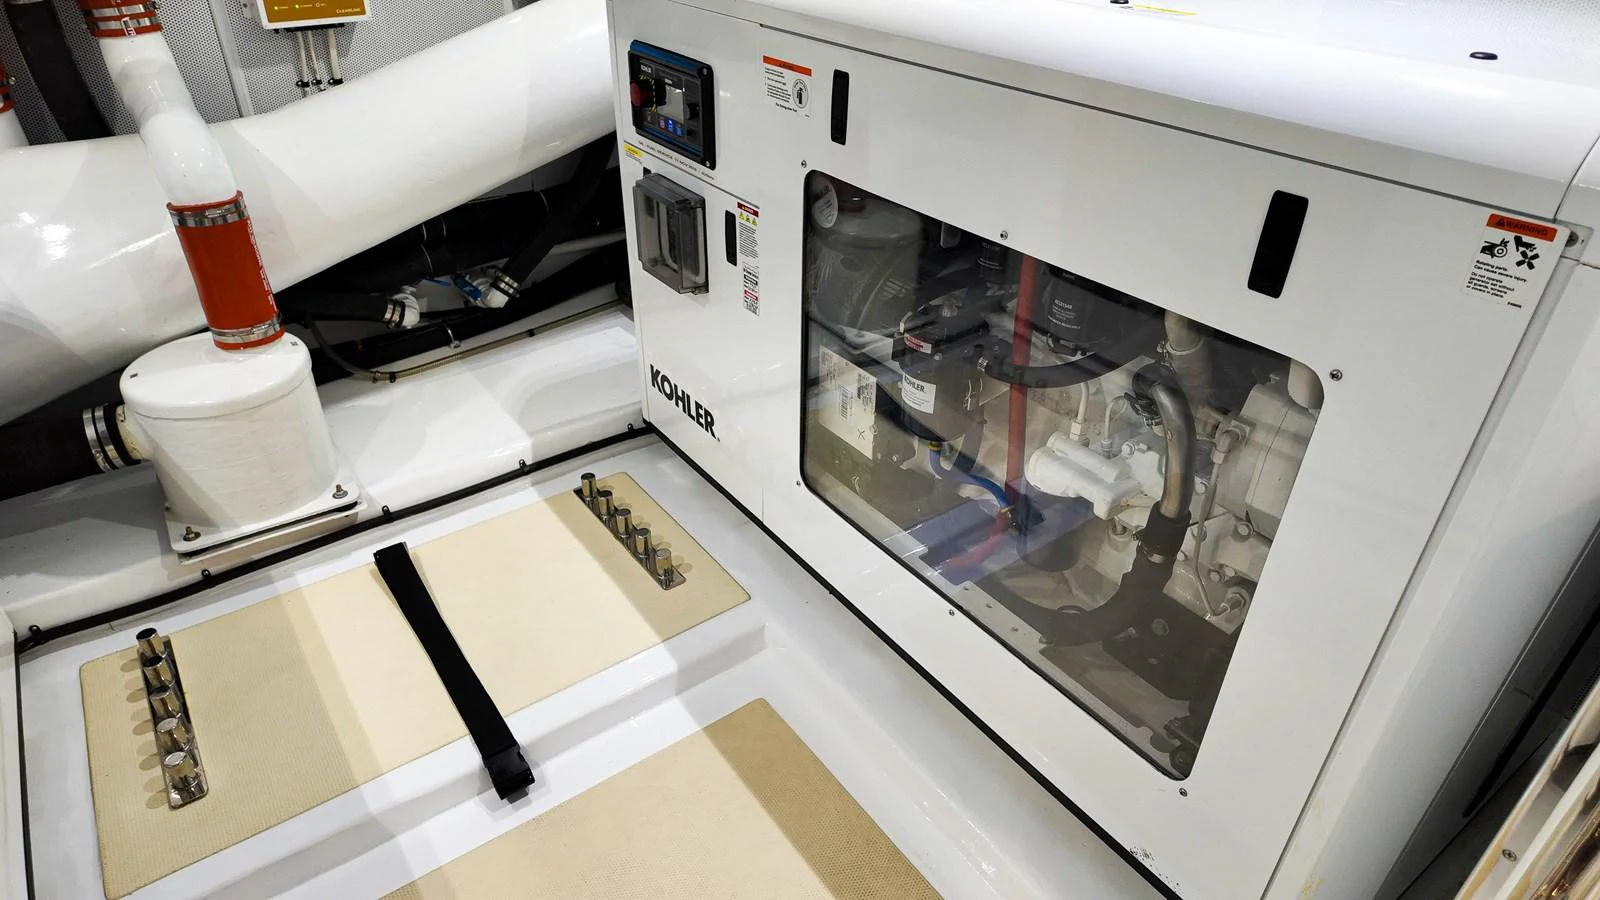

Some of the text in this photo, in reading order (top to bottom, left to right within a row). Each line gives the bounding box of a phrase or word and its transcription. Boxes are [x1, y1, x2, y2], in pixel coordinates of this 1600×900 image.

[1506, 219, 1549, 236] WARNING
[1476, 260, 1495, 269] Rotating
[1469, 277, 1490, 285] generator
[1498, 284, 1515, 292] without
[650, 363, 717, 440] KOHLER
